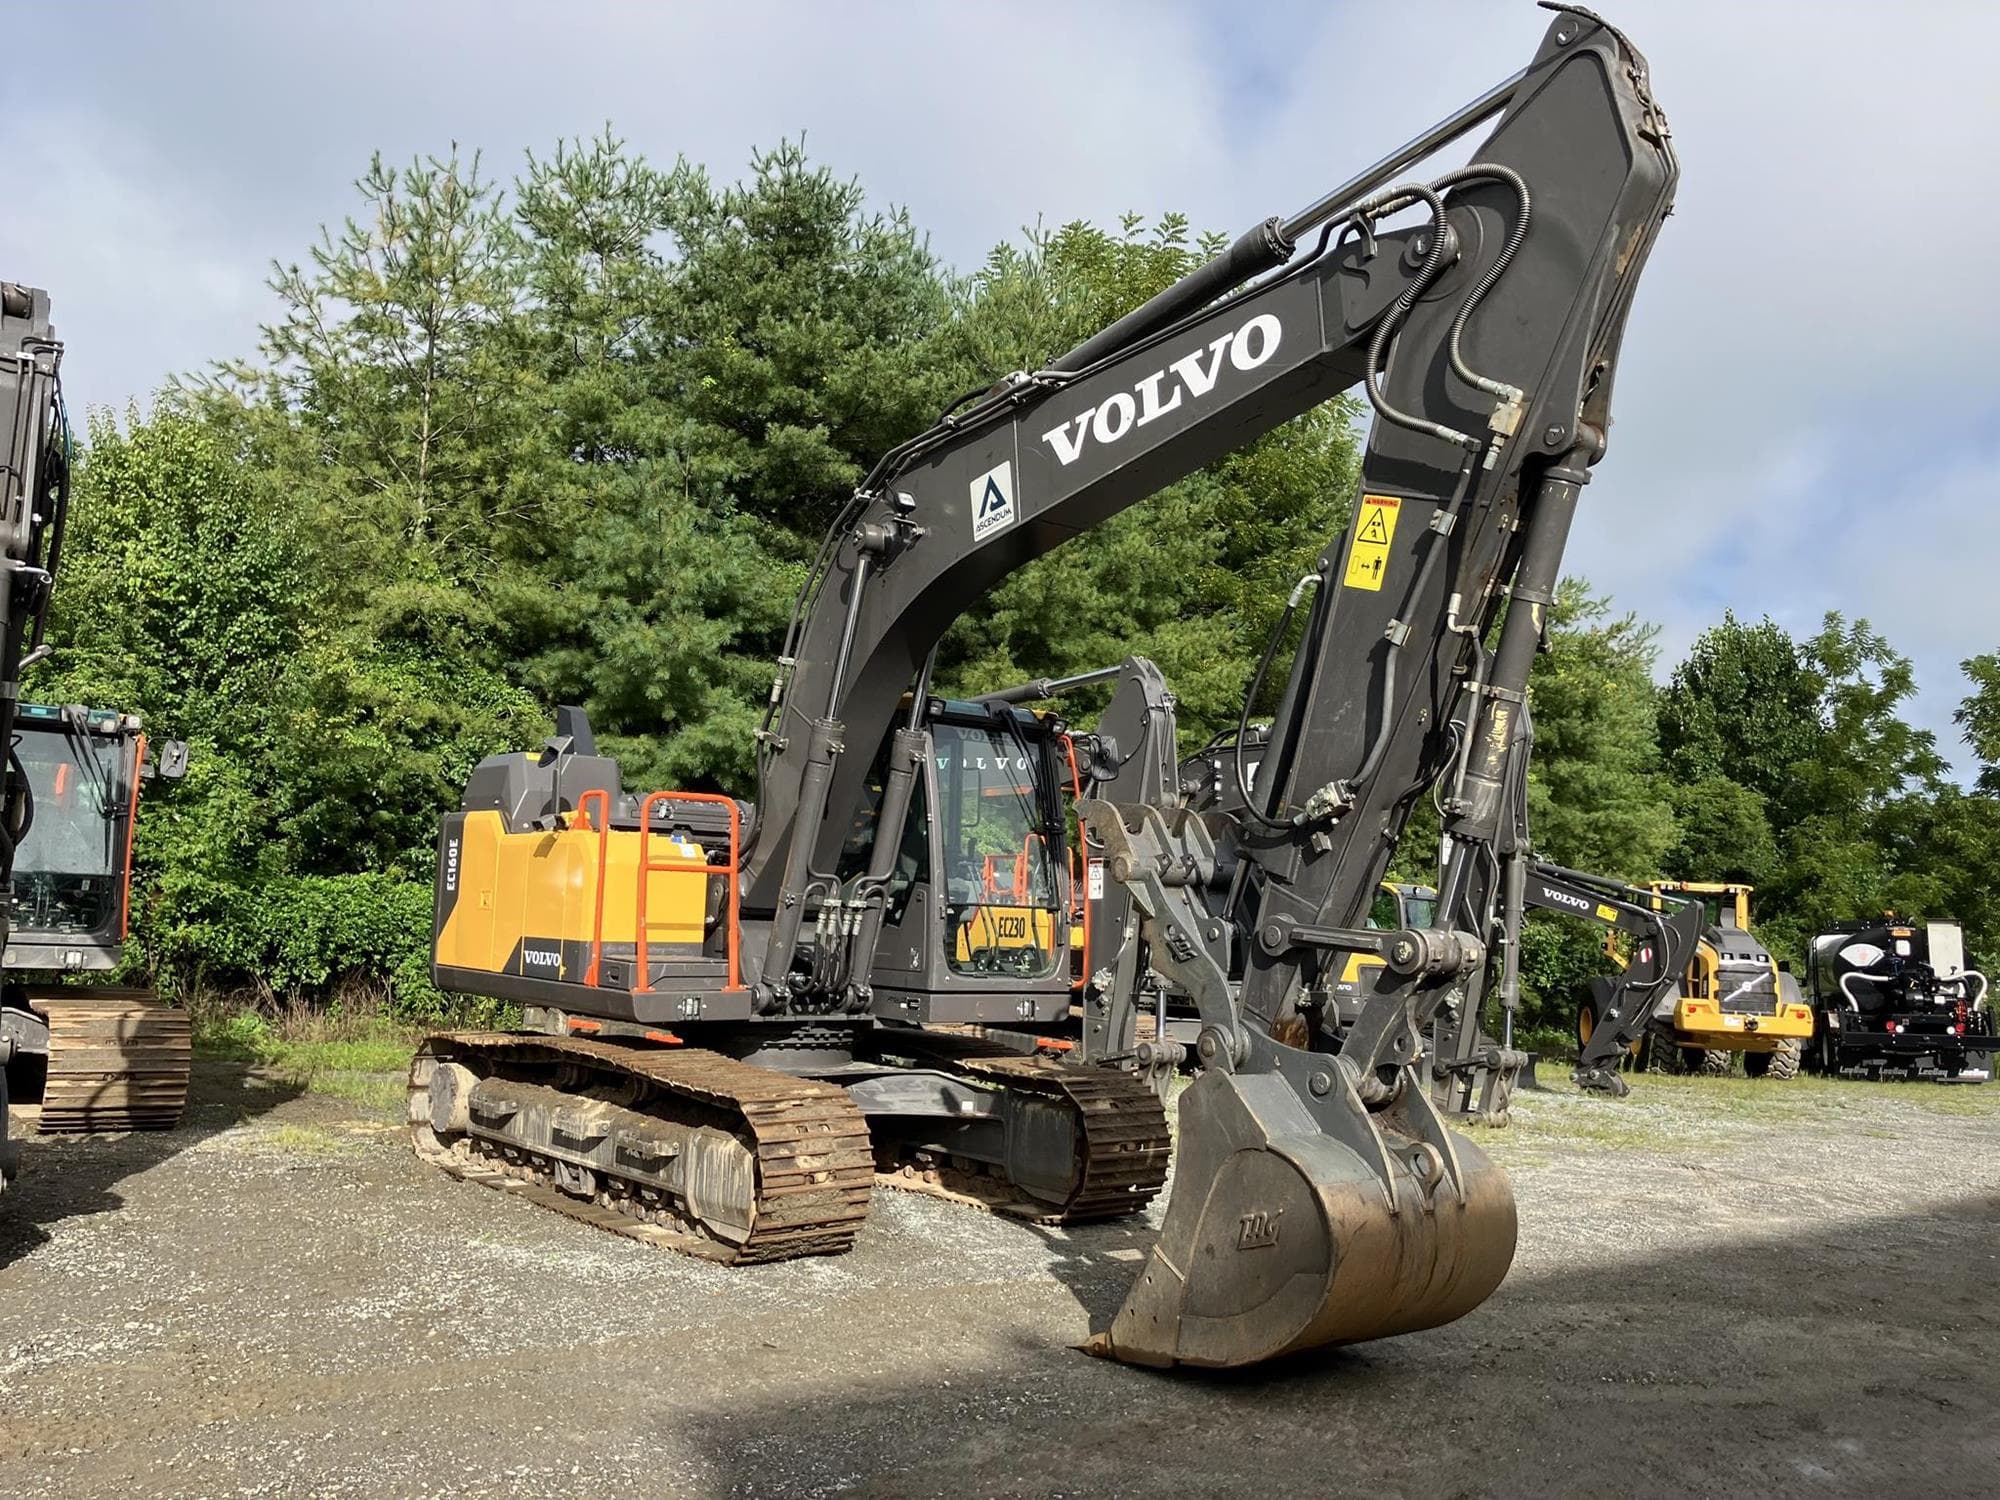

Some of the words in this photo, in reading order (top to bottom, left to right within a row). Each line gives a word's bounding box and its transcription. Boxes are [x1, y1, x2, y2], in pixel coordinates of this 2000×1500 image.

[1042, 314, 1282, 466] VOLVO
[976, 508, 1012, 533] ASCENDUM
[446, 838, 458, 891] EC160E
[1542, 887, 1590, 910] VOLVO
[998, 916, 1025, 939] EC230
[524, 950, 561, 967] VOLVO
[1918, 1066, 1948, 1077] LeeBoy
